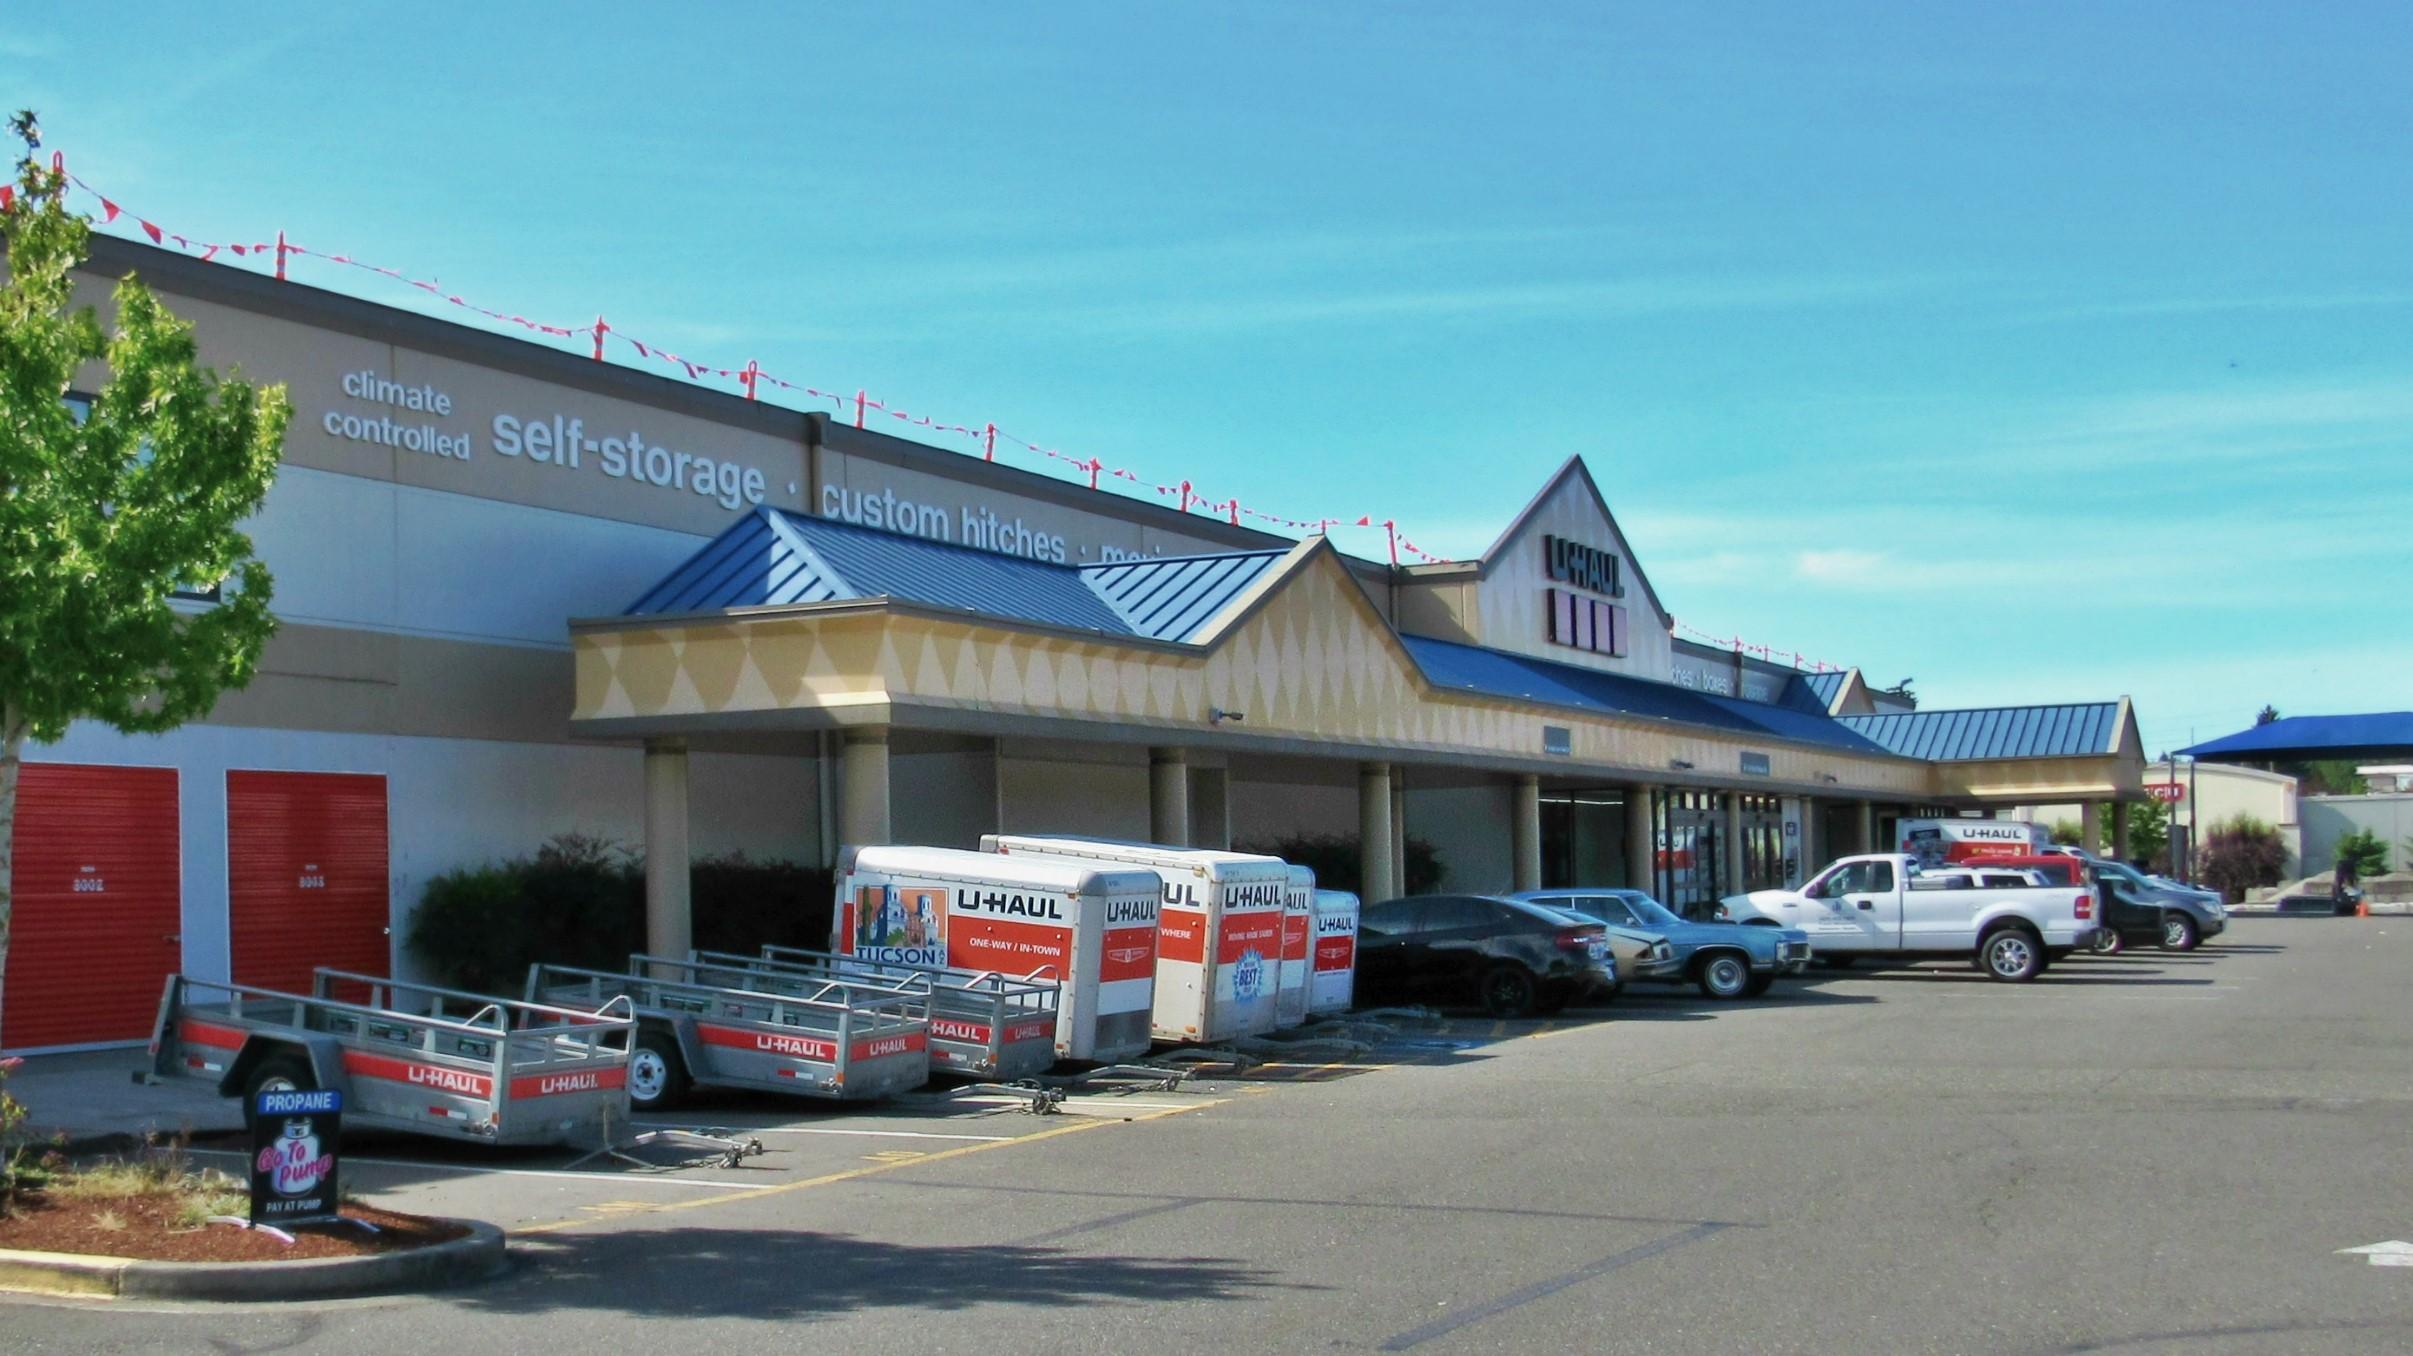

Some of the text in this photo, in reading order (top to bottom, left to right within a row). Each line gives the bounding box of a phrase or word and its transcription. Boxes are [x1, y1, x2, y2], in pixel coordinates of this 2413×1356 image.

[342, 370, 452, 416] climate
[323, 411, 471, 461] controlled
[492, 413, 766, 510] self-storage
[822, 484, 1066, 564] custom hitches
[1545, 534, 1625, 598] U-HAUL
[1963, 829, 2022, 839] U-HAUL
[957, 887, 1063, 920] U-HAUL
[1224, 885, 1281, 909] U-HAUL
[1106, 900, 1156, 922] U-HAUL
[1318, 917, 1353, 932] U-HAUL
[855, 946, 936, 964] TUCSON
[969, 937, 1012, 951] ONE-WAY
[1019, 943, 1061, 956] IN-TOWN
[1239, 968, 1258, 987] BEST
[931, 1022, 981, 1041] -HAUL
[756, 1035, 826, 1058] U-HAUL
[869, 1038, 908, 1057] U-HAUL
[408, 1065, 483, 1095] U-HAUL
[541, 1073, 599, 1094] U-HAUL
[266, 1092, 333, 1112] PROPANE
[266, 1199, 322, 1213] PAY AT PUMP
